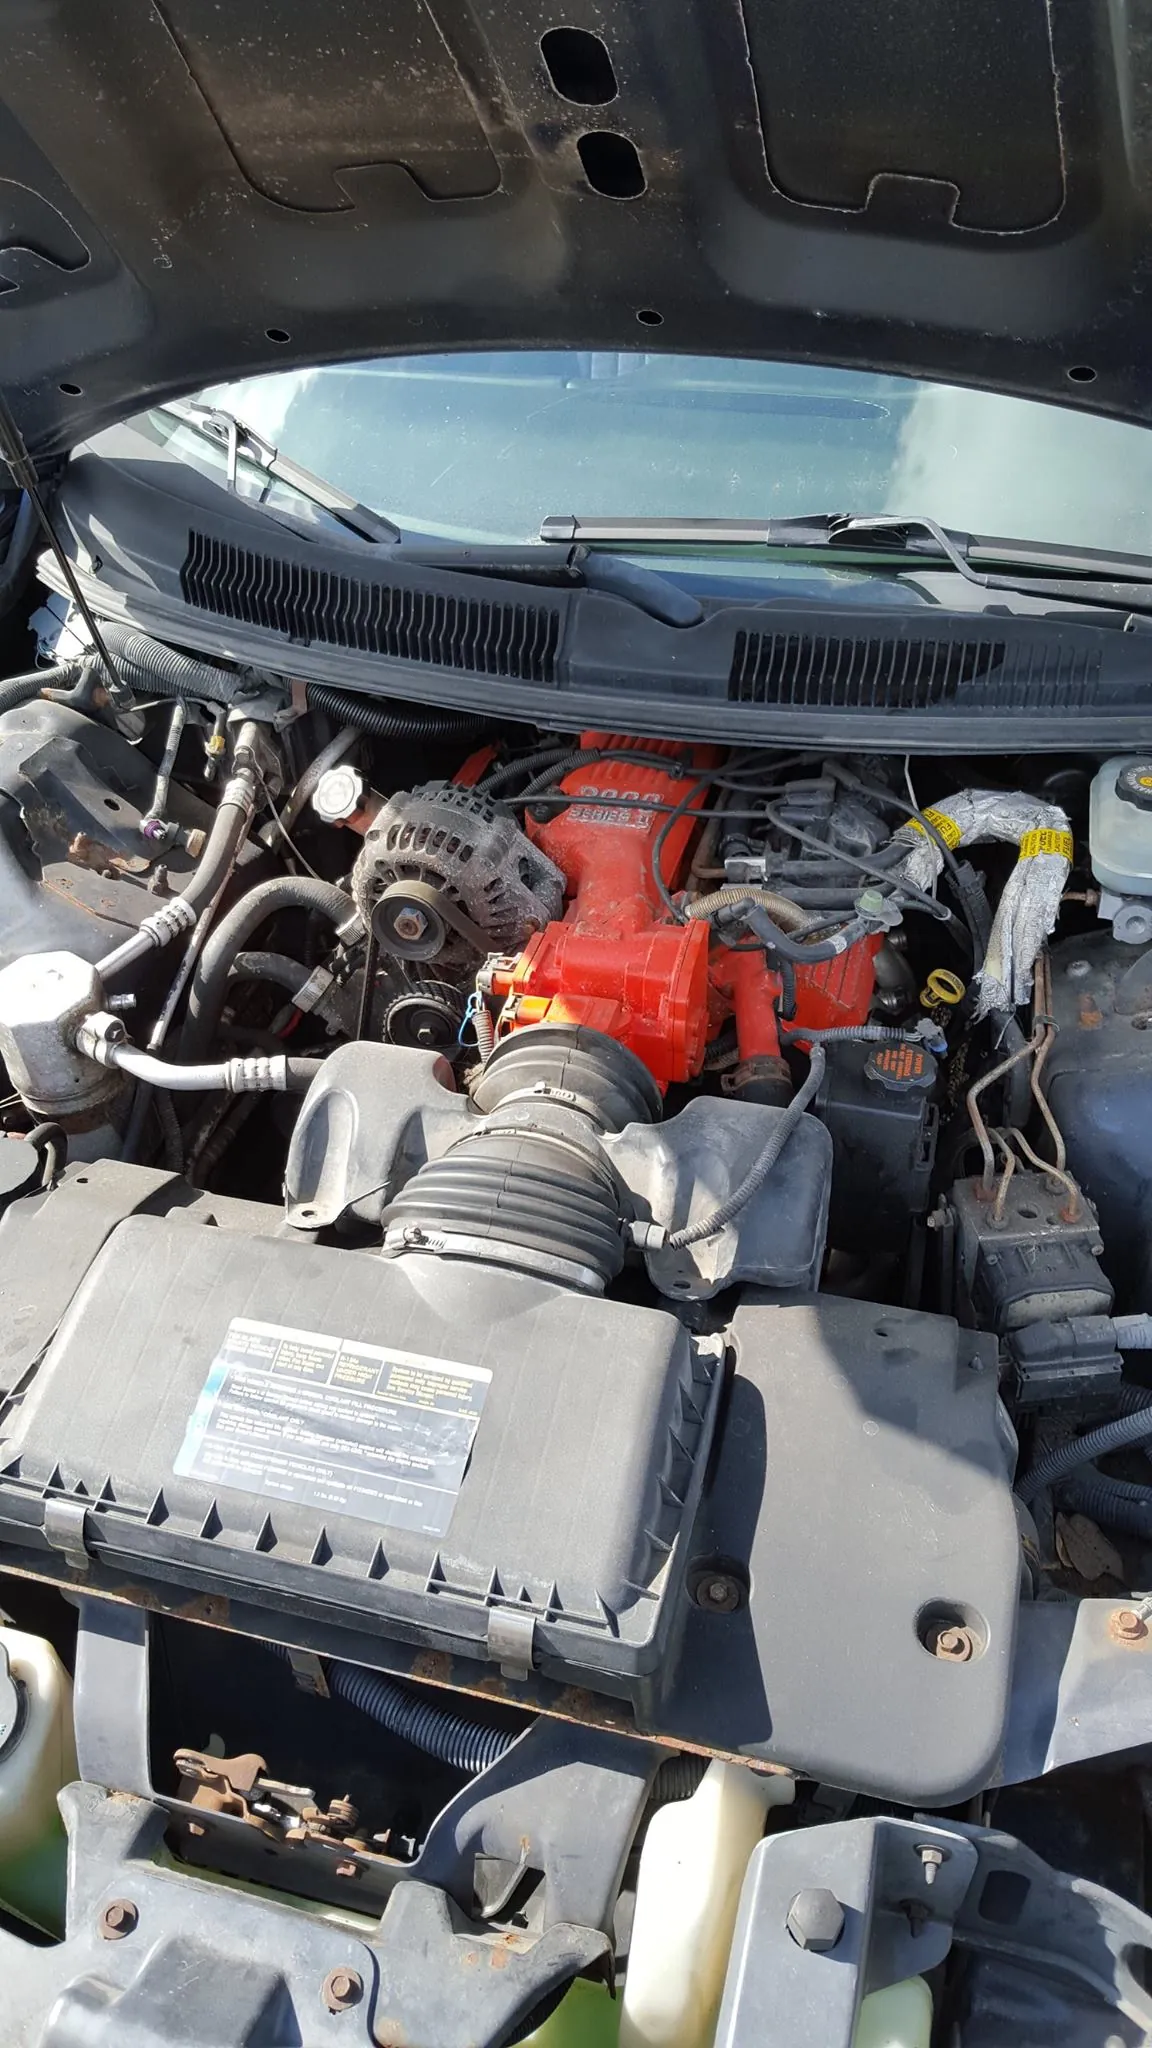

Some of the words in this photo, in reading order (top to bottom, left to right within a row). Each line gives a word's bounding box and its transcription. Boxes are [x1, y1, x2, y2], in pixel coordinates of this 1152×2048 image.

[569, 807, 630, 822] SERIES
[903, 1049, 913, 1076] STEERING
[913, 1053, 923, 1073] POWER
